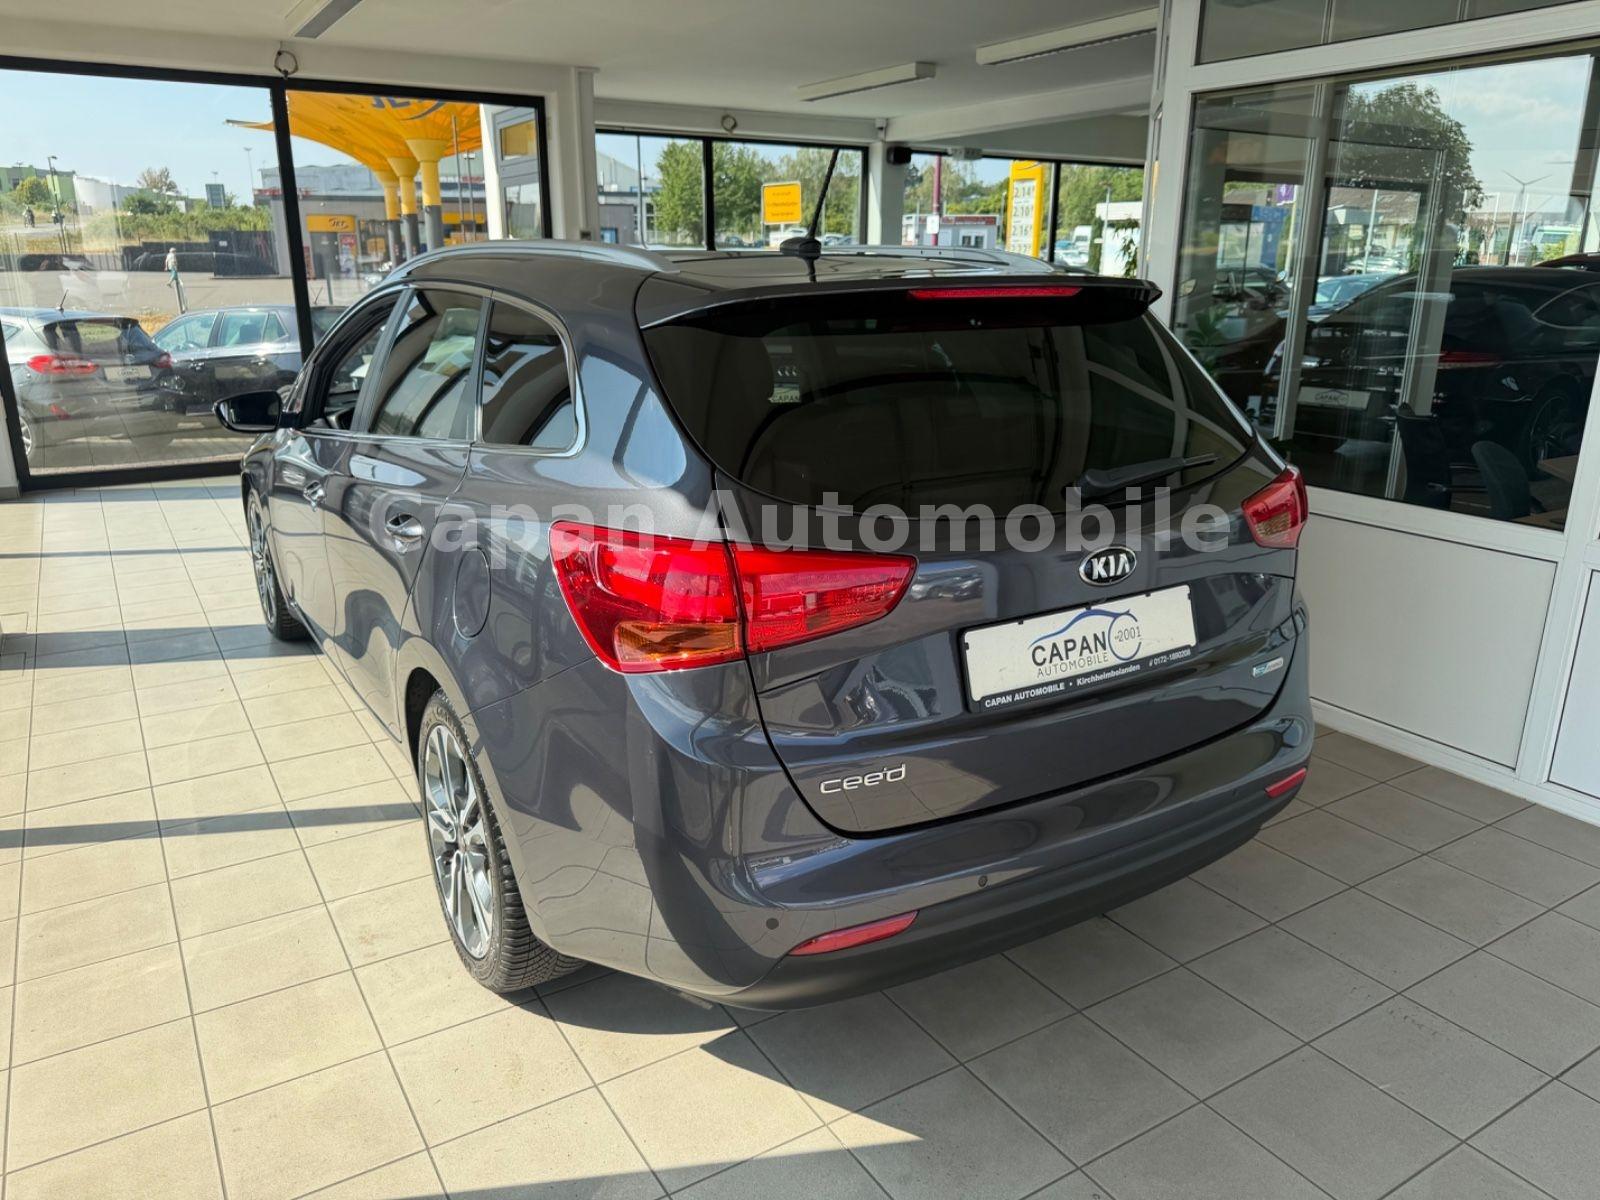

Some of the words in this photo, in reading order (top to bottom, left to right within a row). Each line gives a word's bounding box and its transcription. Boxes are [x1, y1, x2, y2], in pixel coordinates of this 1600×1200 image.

[1090, 553, 1130, 580] KIA
[1031, 631, 1107, 667] CAPAN
[1036, 652, 1109, 679] AUTOMOBILE
[985, 694, 1013, 708] CAPAN
[1014, 683, 1065, 701] AUTOMOBILE
